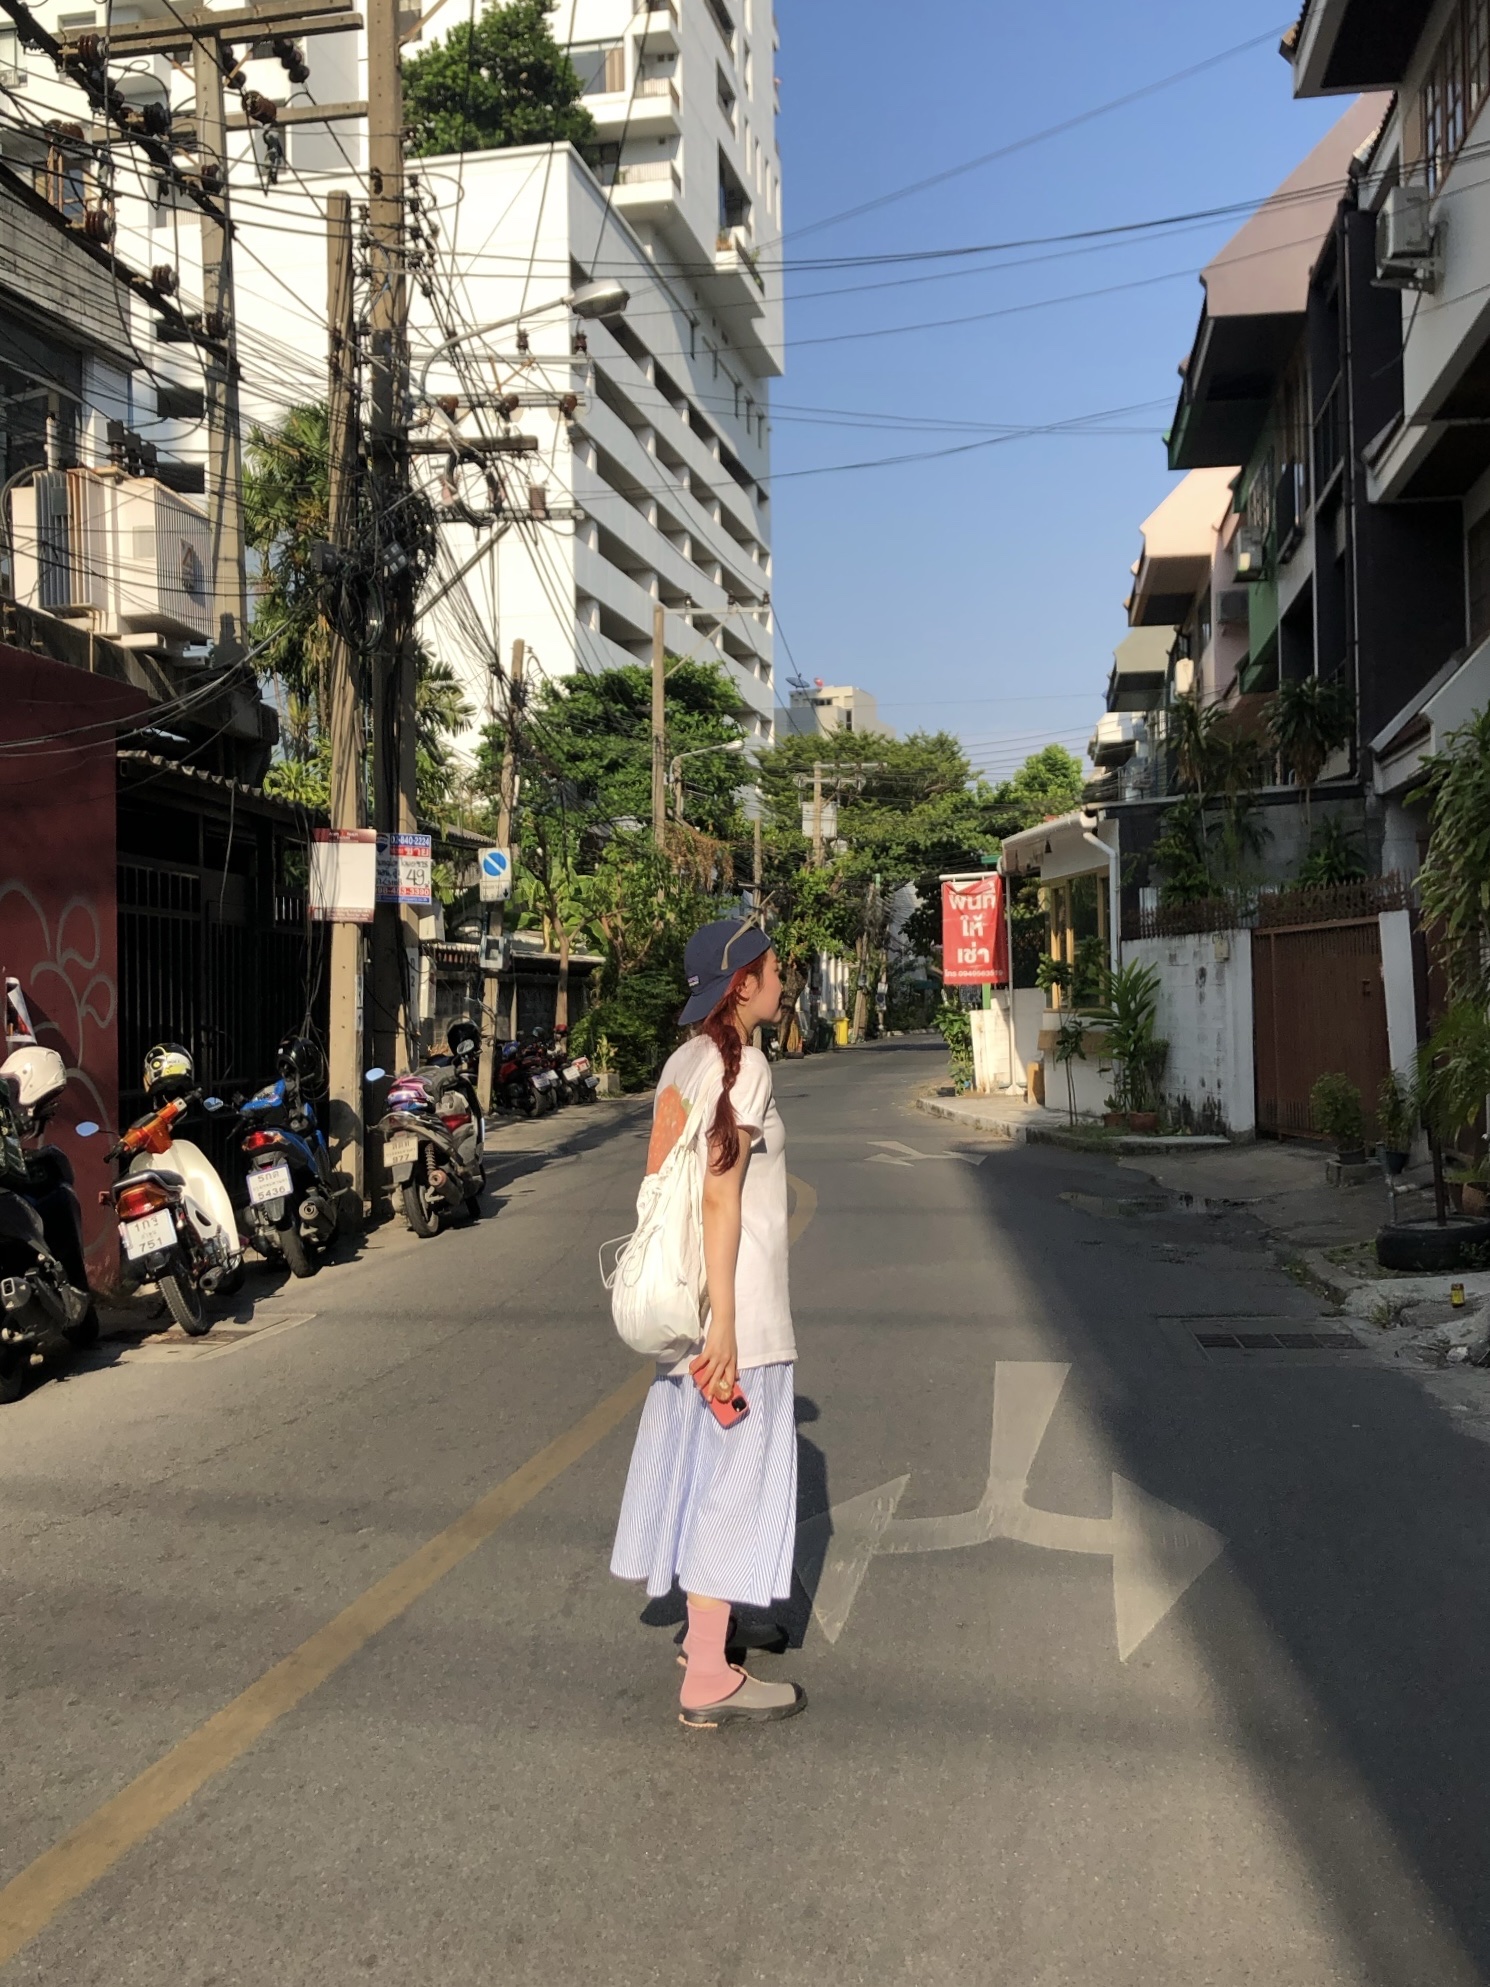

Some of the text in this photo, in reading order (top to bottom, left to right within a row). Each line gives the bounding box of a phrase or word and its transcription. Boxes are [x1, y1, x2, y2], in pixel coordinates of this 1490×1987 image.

[406, 869, 425, 886] 49
[957, 941, 990, 964] เช่า
[257, 1185, 286, 1200] 5436
[139, 1236, 163, 1253] 751
